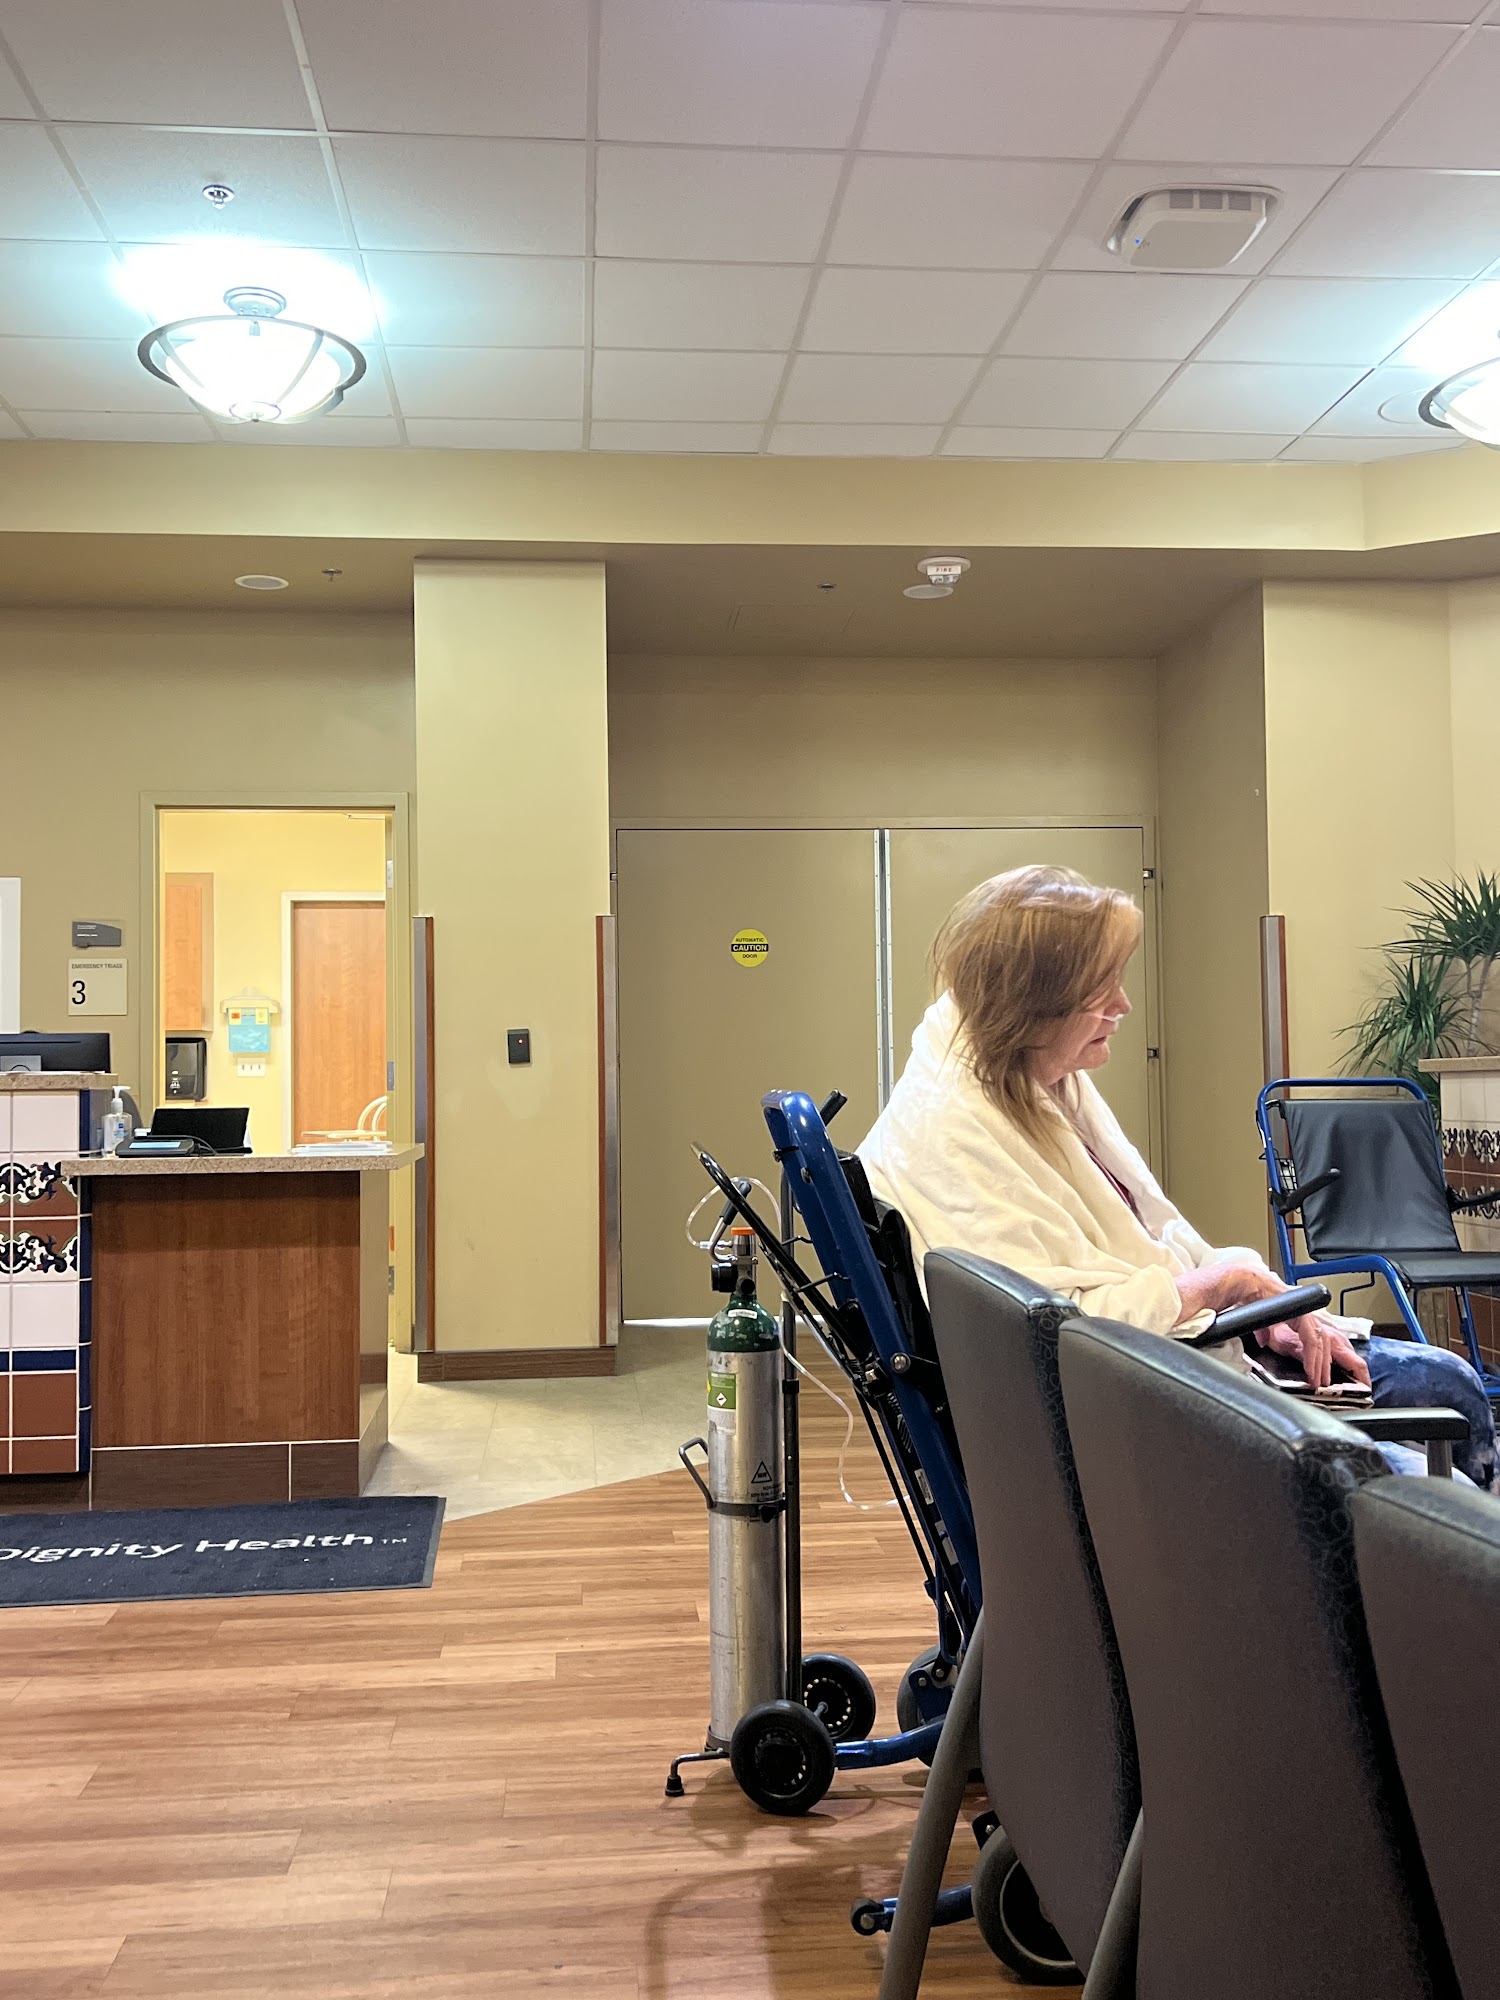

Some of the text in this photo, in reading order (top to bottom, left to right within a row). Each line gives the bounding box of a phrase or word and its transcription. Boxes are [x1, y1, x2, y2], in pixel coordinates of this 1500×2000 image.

[732, 944, 767, 952] CAUTION
[71, 980, 86, 1005] 3
[195, 1534, 374, 1553] Health
